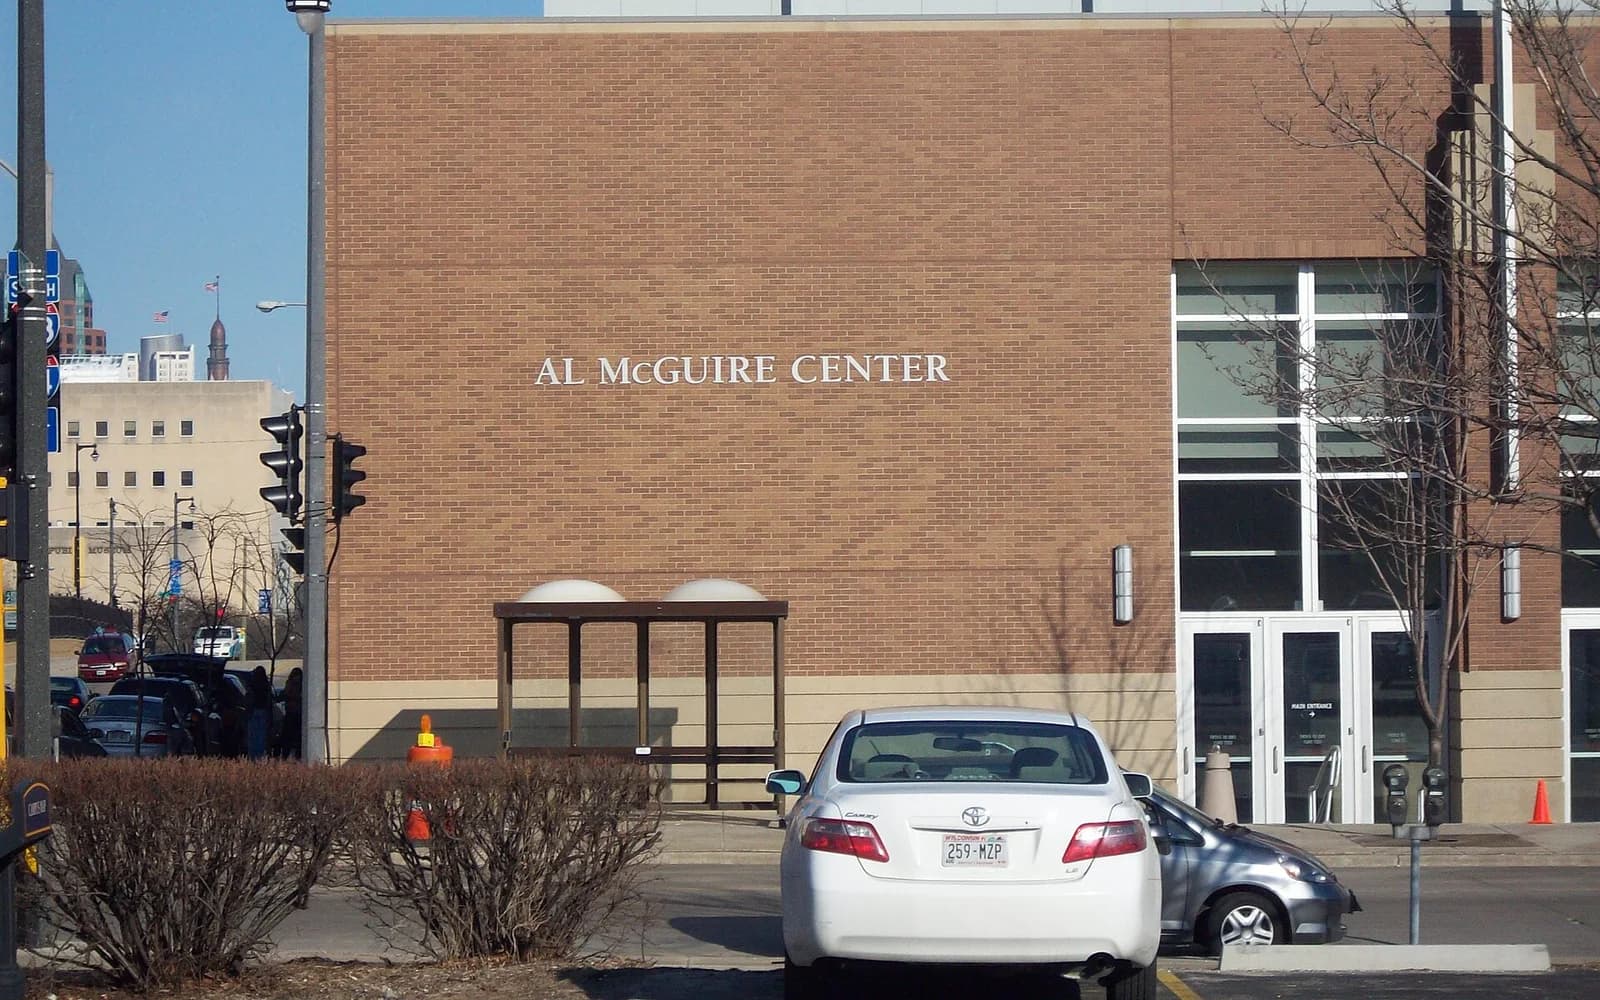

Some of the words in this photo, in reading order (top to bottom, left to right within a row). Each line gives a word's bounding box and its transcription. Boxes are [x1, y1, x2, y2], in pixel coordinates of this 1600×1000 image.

[534, 357, 585, 386] AL
[598, 355, 777, 385] McGUIRE
[790, 353, 951, 384] CENTER
[88, 546, 133, 554] MUSUM
[948, 843, 1002, 859] 259-MZP
